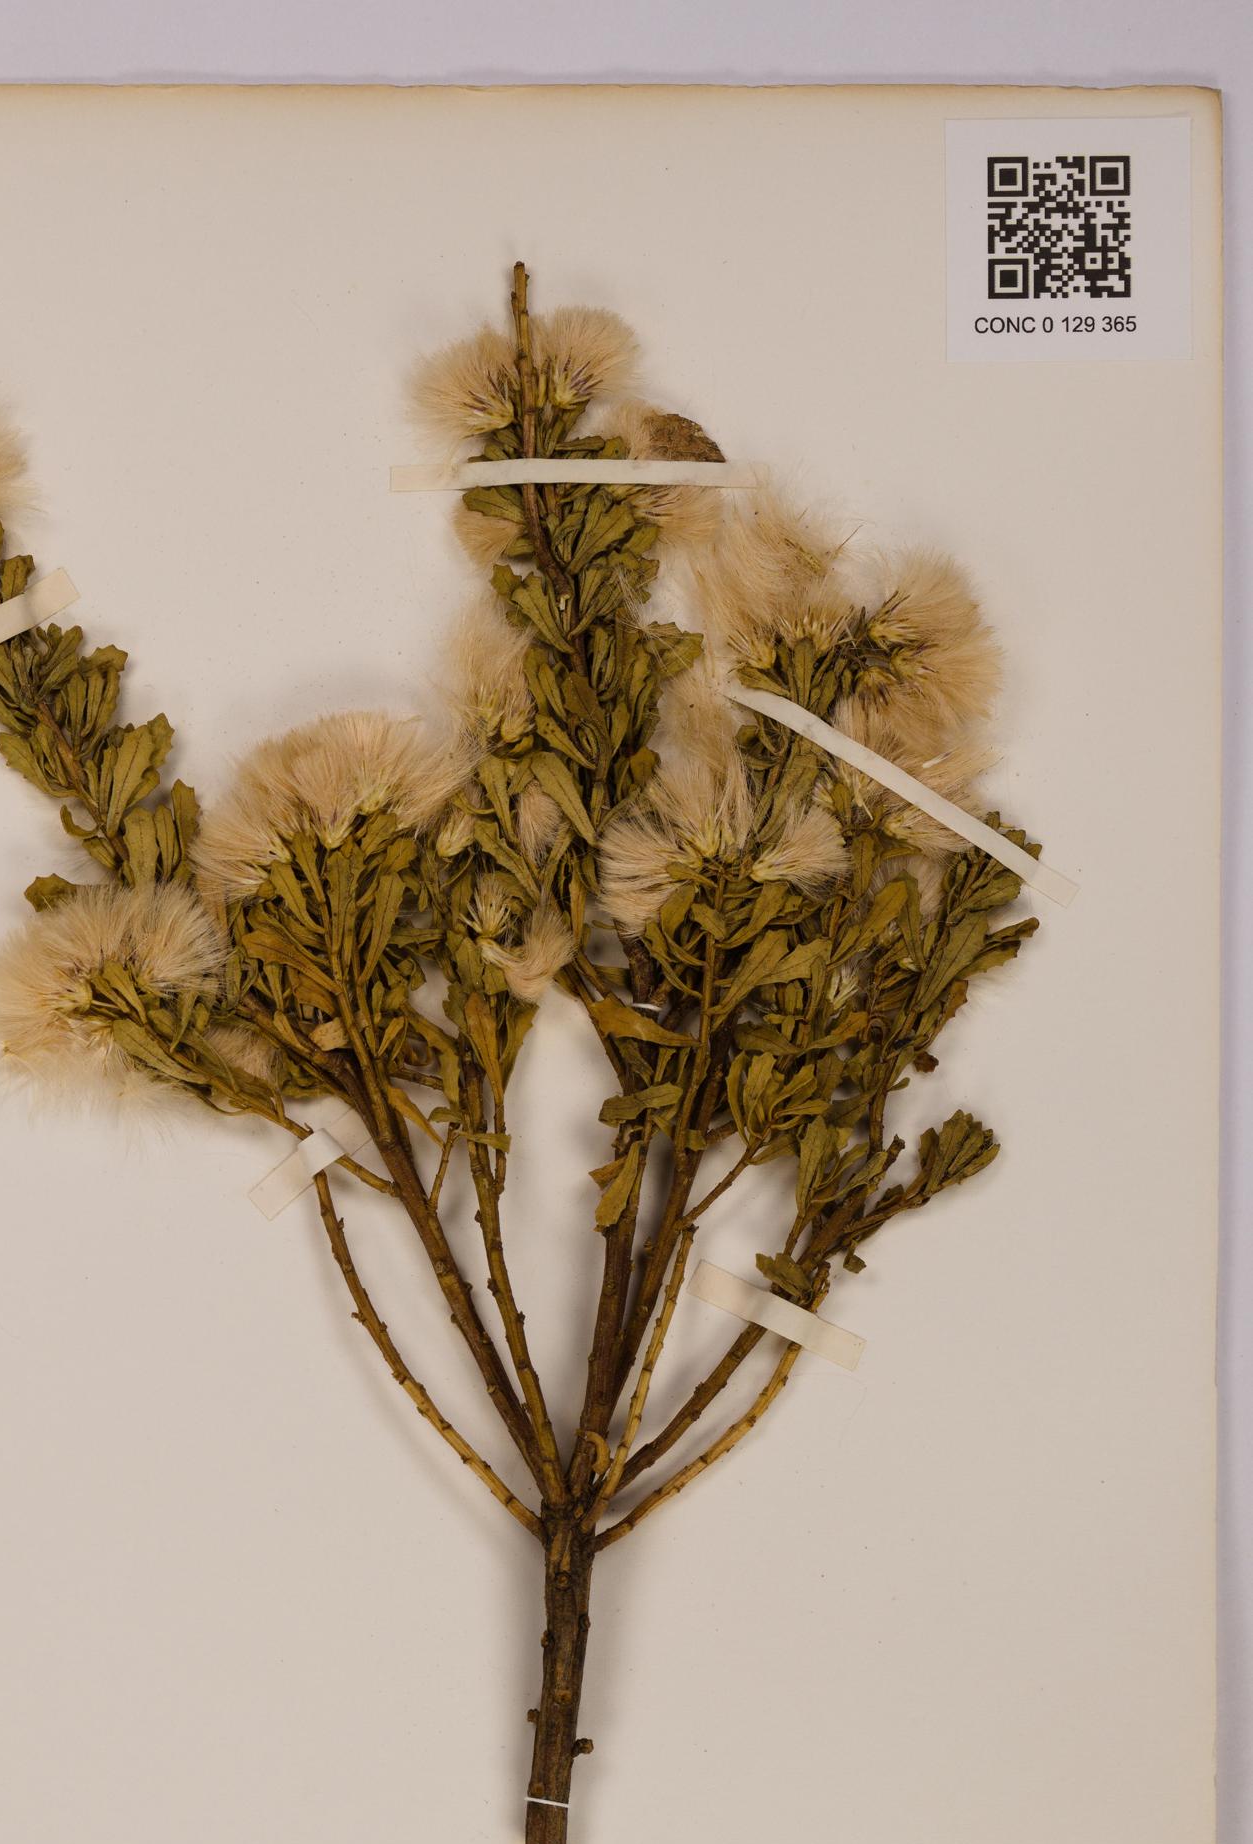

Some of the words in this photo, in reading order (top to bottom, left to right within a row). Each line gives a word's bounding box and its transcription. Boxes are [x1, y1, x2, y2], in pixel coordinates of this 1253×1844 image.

[974, 316, 1036, 334] CONC
[1042, 316, 1054, 334] 0
[1061, 315, 1096, 333] 129
[1101, 315, 1137, 333] 365
